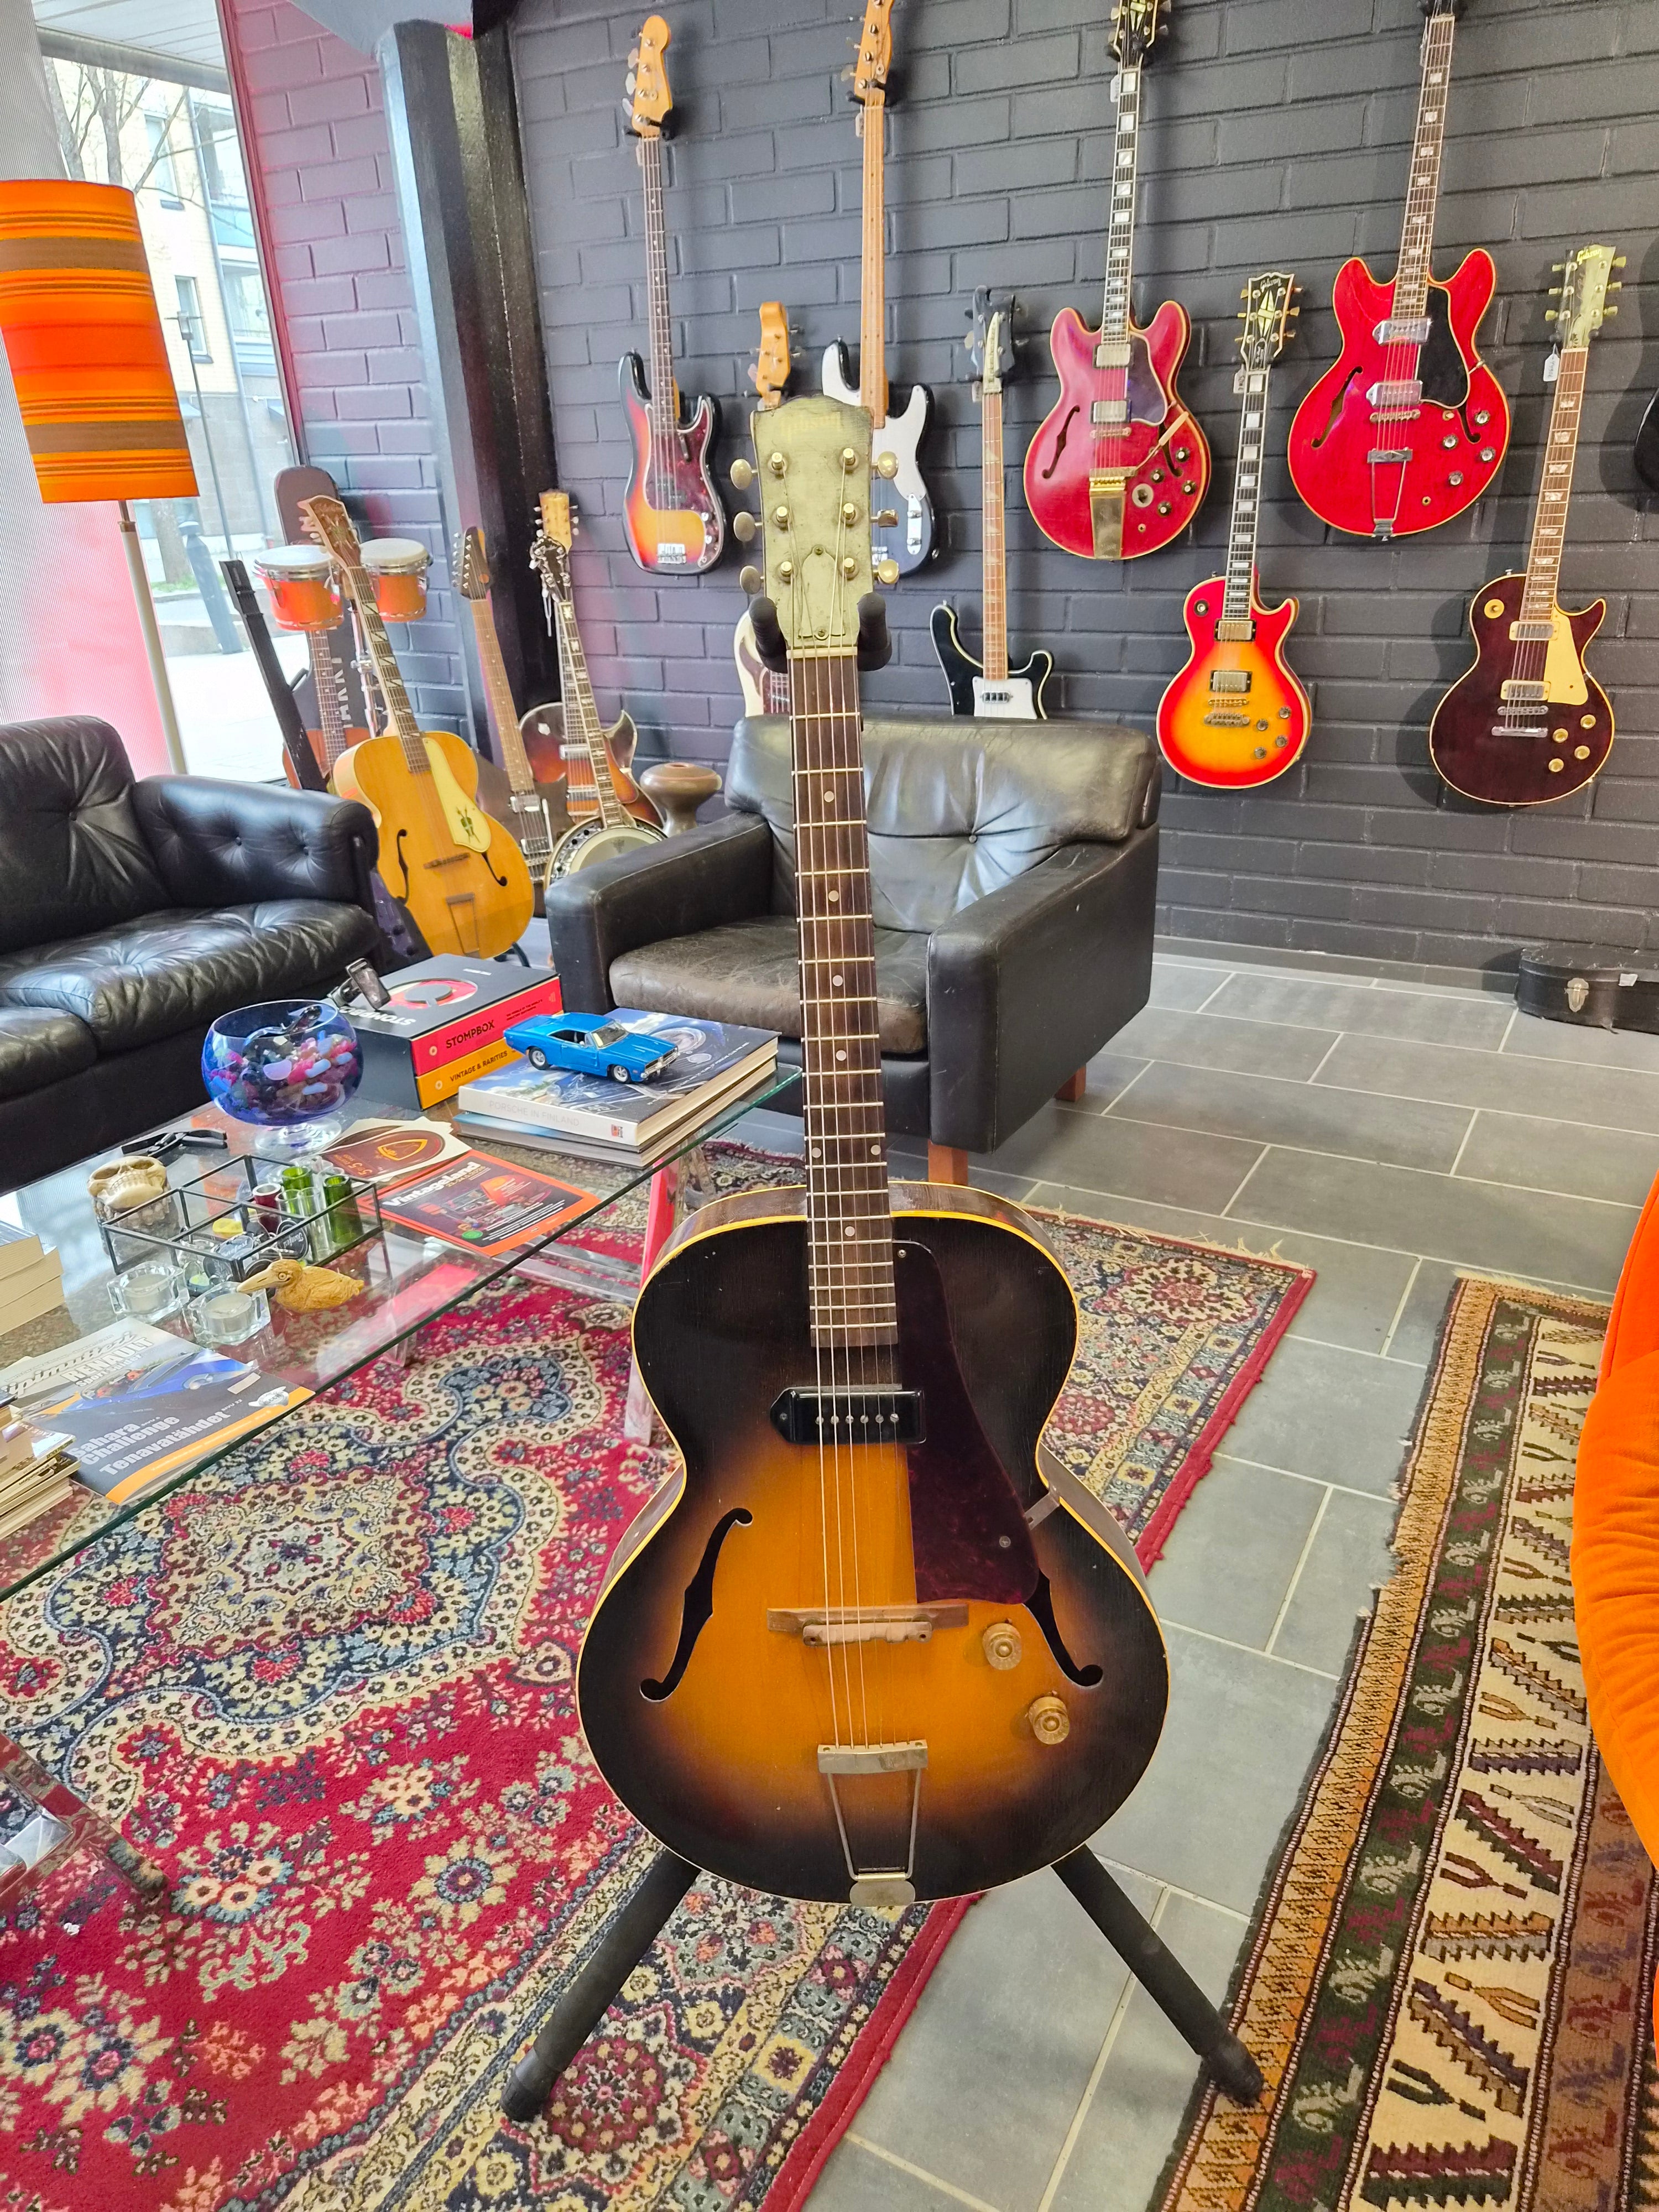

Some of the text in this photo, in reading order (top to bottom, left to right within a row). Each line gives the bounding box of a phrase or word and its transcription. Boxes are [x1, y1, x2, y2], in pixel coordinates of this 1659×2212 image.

[1577, 248, 1603, 265] Gibson
[1260, 278, 1282, 293] Gibson
[339, 1006, 416, 1025] STOMPBO
[446, 1019, 495, 1049] STOMPBOX
[450, 1064, 476, 1082] VINTAGE
[482, 1051, 508, 1067] RARITIES
[489, 1100, 580, 1126] PORSCHE IN FINLAND
[382, 1161, 482, 1206] Vintageland
[61, 1336, 154, 1382] RENAULT
[75, 1369, 109, 1387] Sport
[68, 1422, 141, 1457] Sahara
[81, 1416, 180, 1465] Challenge
[99, 1410, 231, 1475] Tenavatähdet
